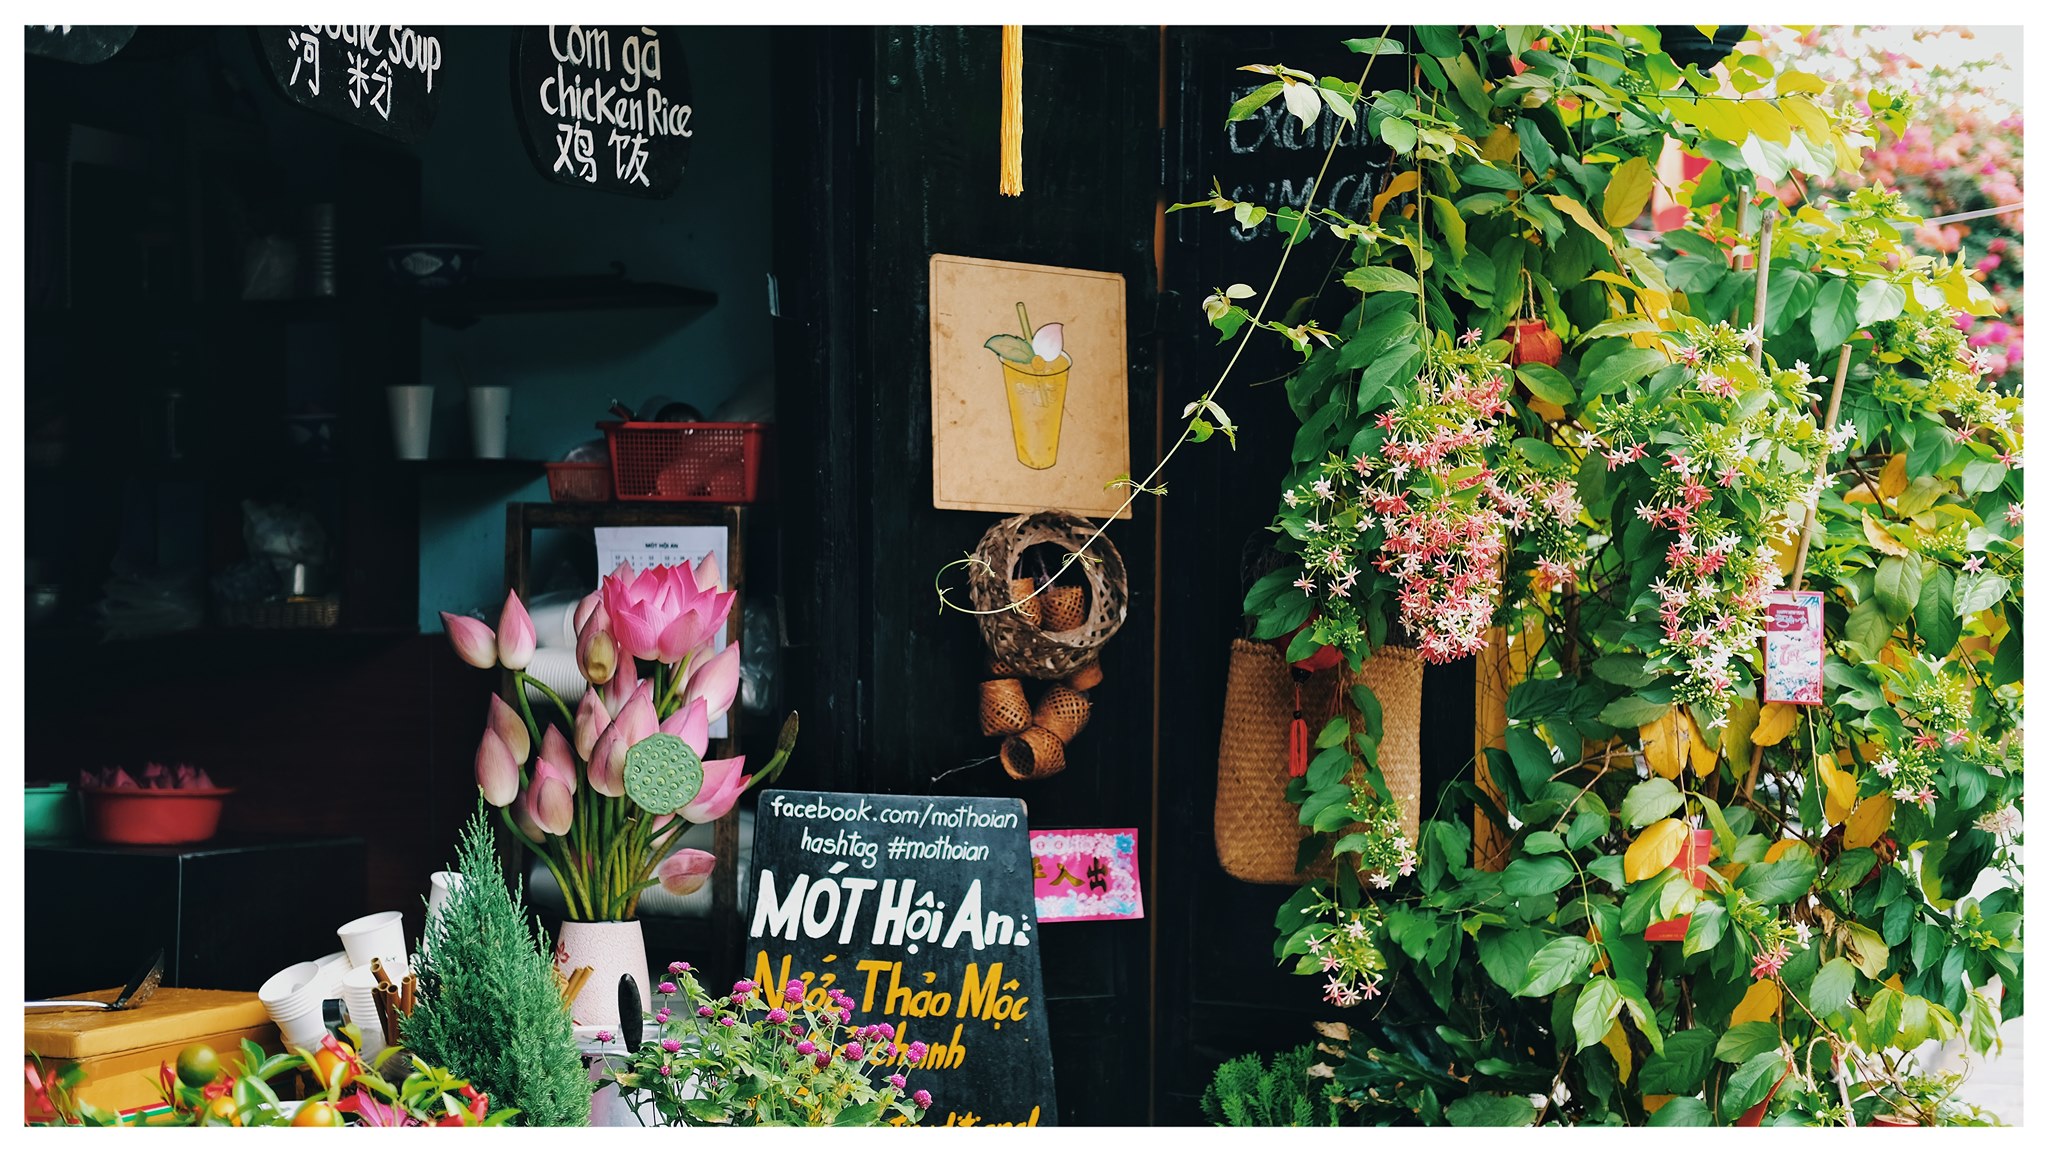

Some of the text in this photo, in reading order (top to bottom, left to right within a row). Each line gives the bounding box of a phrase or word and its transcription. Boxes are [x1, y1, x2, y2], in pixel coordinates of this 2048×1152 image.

[620, 26, 661, 93] gà
[647, 87, 693, 138] Rice
[770, 796, 1018, 829] facebook.com/mothoian
[800, 826, 989, 869] hashtag #mothoian
[750, 861, 877, 944] MÓT
[871, 879, 945, 954] Hội
[856, 960, 951, 1018] Thảo
[956, 962, 1029, 1030] Mộc
[868, 1021, 966, 1070] chnh
